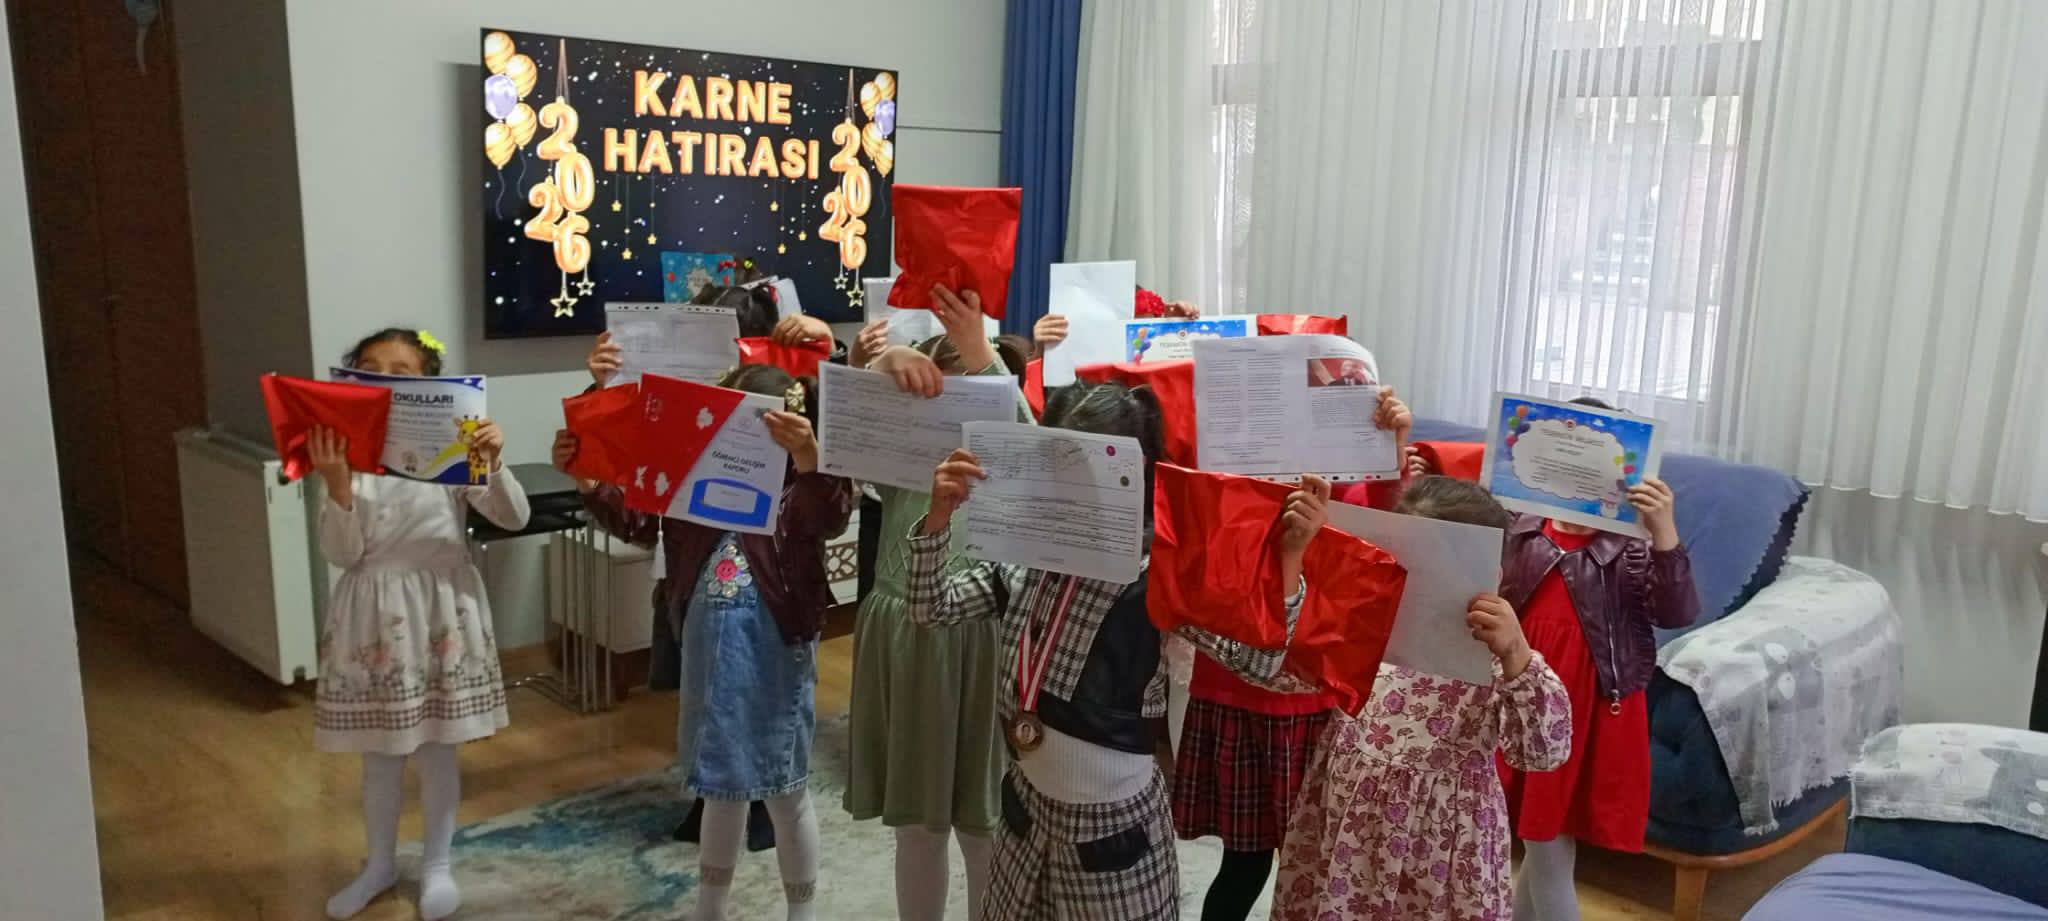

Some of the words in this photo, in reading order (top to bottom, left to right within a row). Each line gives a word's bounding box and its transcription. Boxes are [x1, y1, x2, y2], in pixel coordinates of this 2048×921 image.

[633, 70, 792, 125] KARNE
[603, 128, 820, 179] HATIRASI
[394, 392, 454, 404] OKULLARI
